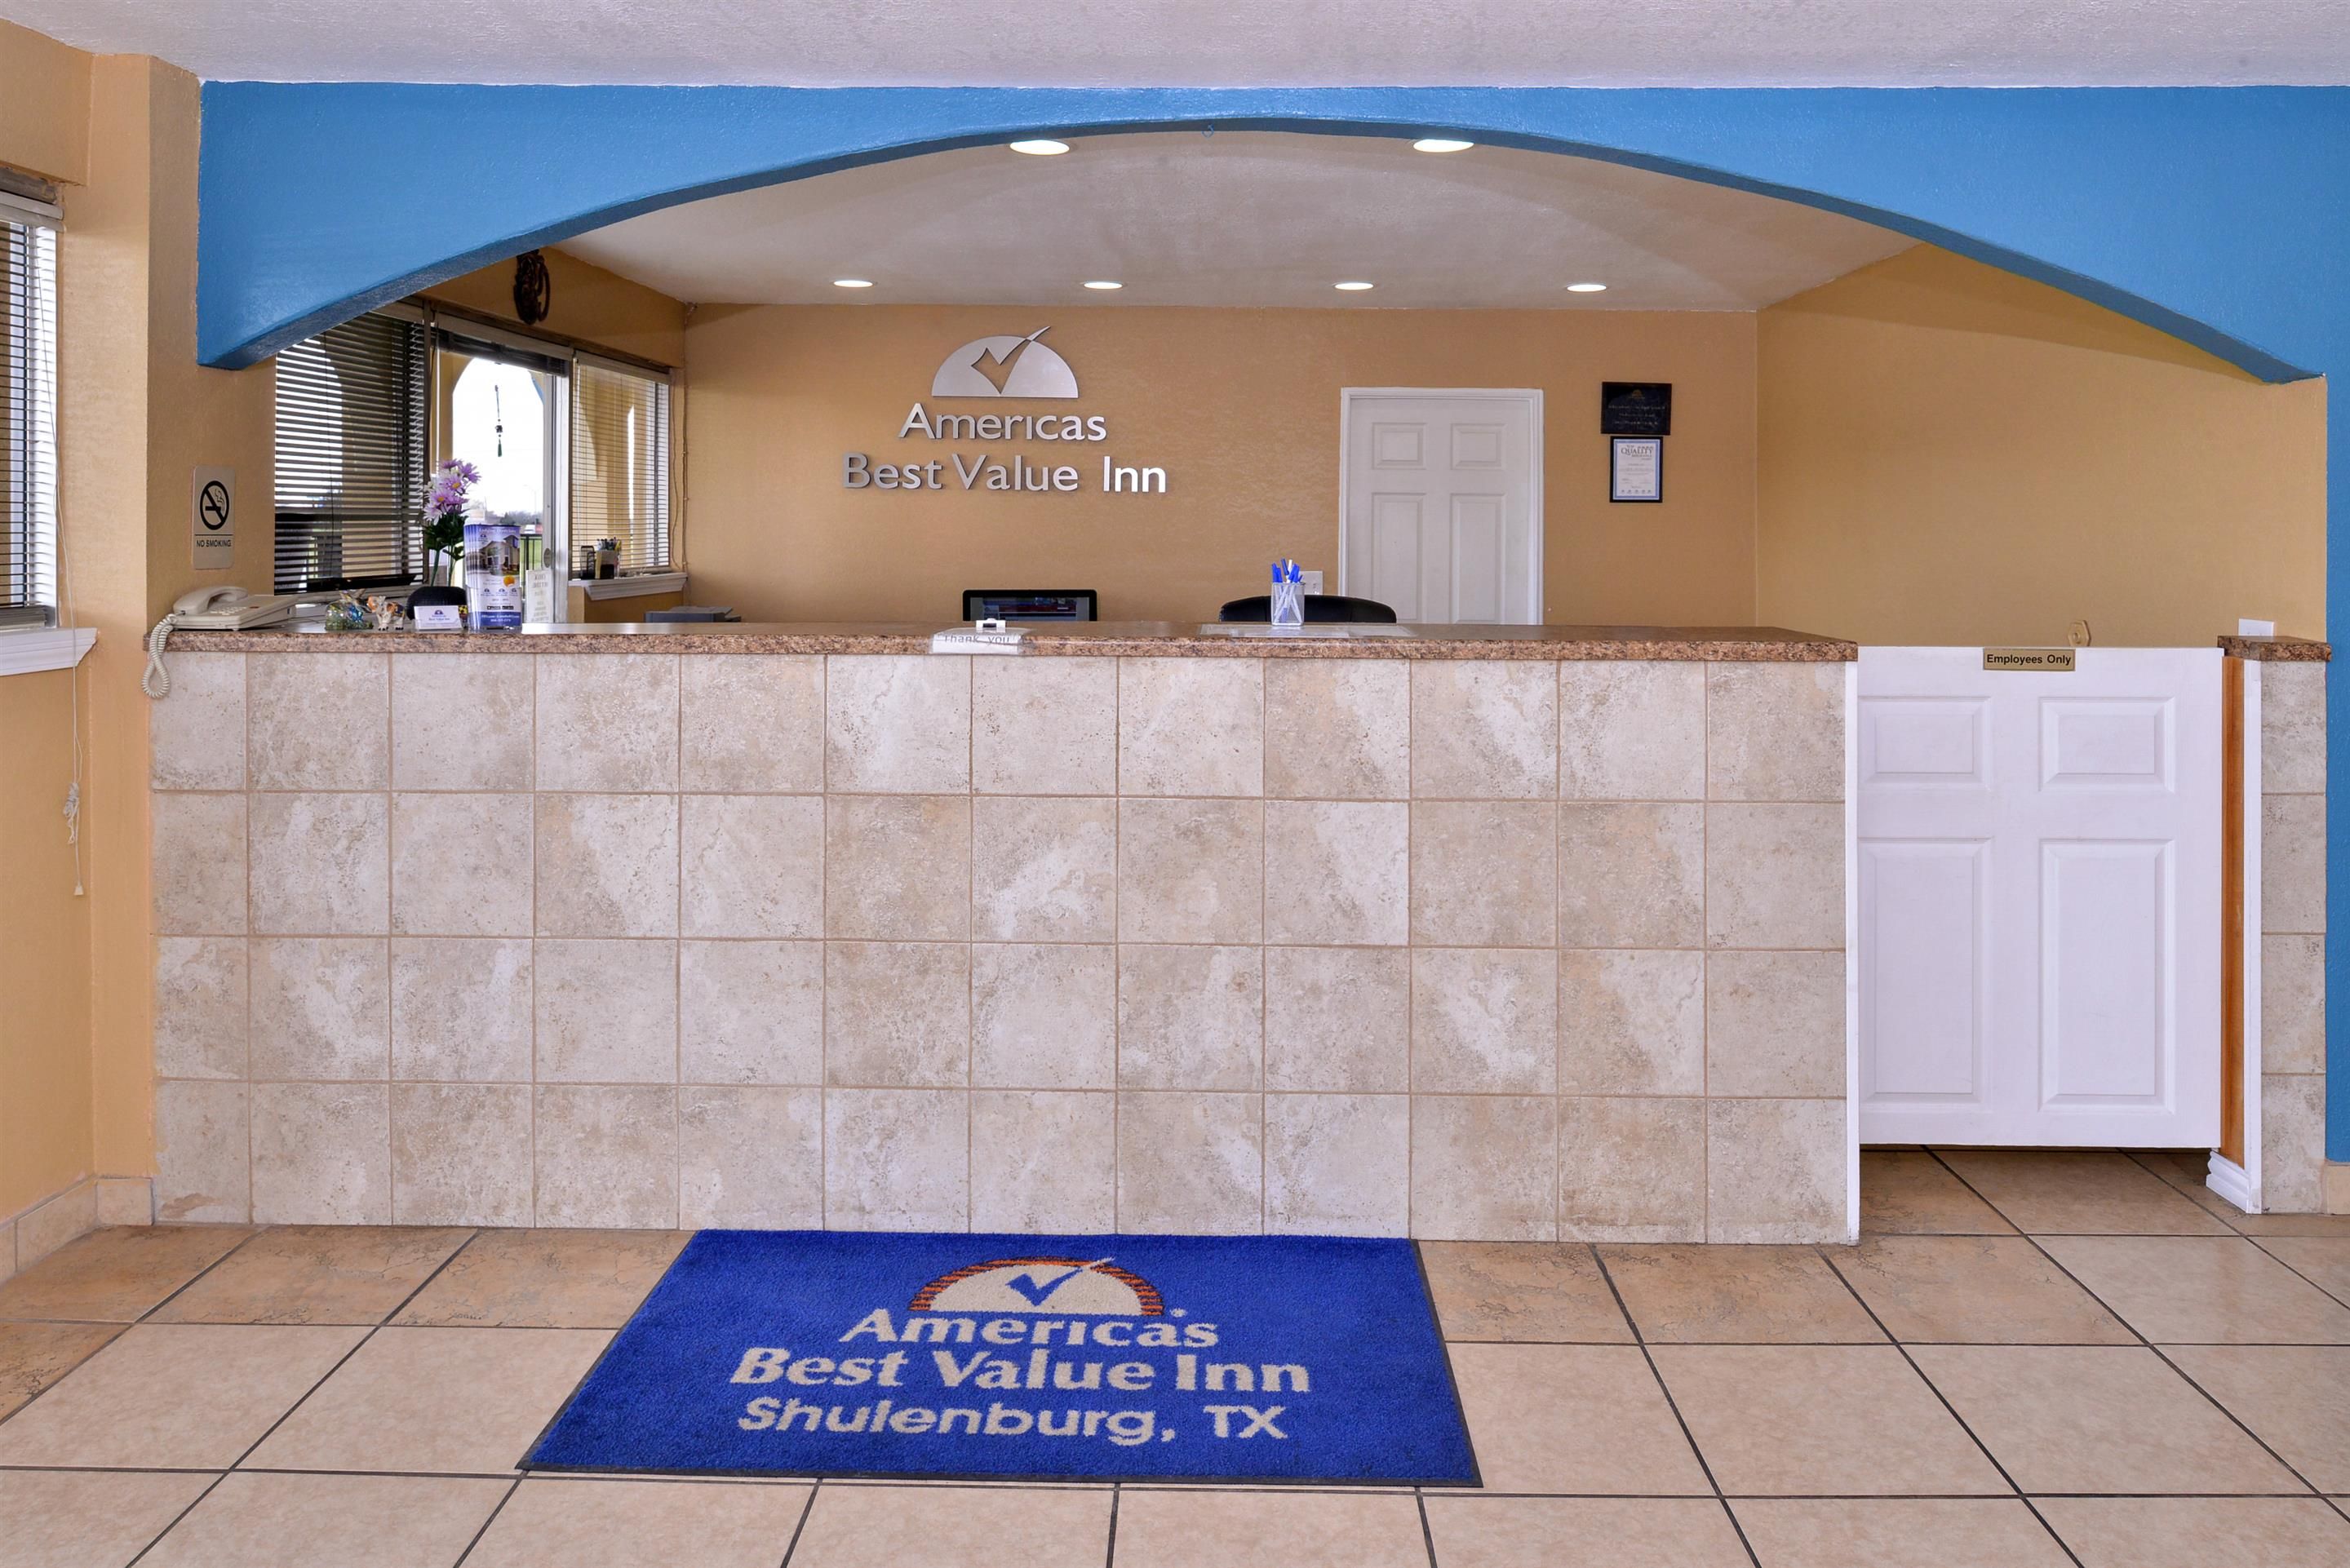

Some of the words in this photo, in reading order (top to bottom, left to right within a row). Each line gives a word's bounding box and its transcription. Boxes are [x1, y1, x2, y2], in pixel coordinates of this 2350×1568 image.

[898, 402, 1107, 441] Americas
[843, 452, 942, 489] Best
[952, 454, 1078, 491] Value
[1103, 456, 1167, 493] Inn
[196, 539, 205, 547] NO
[206, 539, 232, 547] SMOKING
[1987, 653, 2043, 665] Employees
[2046, 653, 2072, 666] Only
[839, 1308, 1218, 1347] Americas
[730, 1347, 909, 1387] Best
[933, 1348, 1155, 1390] Value
[1176, 1353, 1310, 1392] Inn
[738, 1396, 1176, 1446] Shulenburg,
[1204, 1405, 1288, 1438] TX
